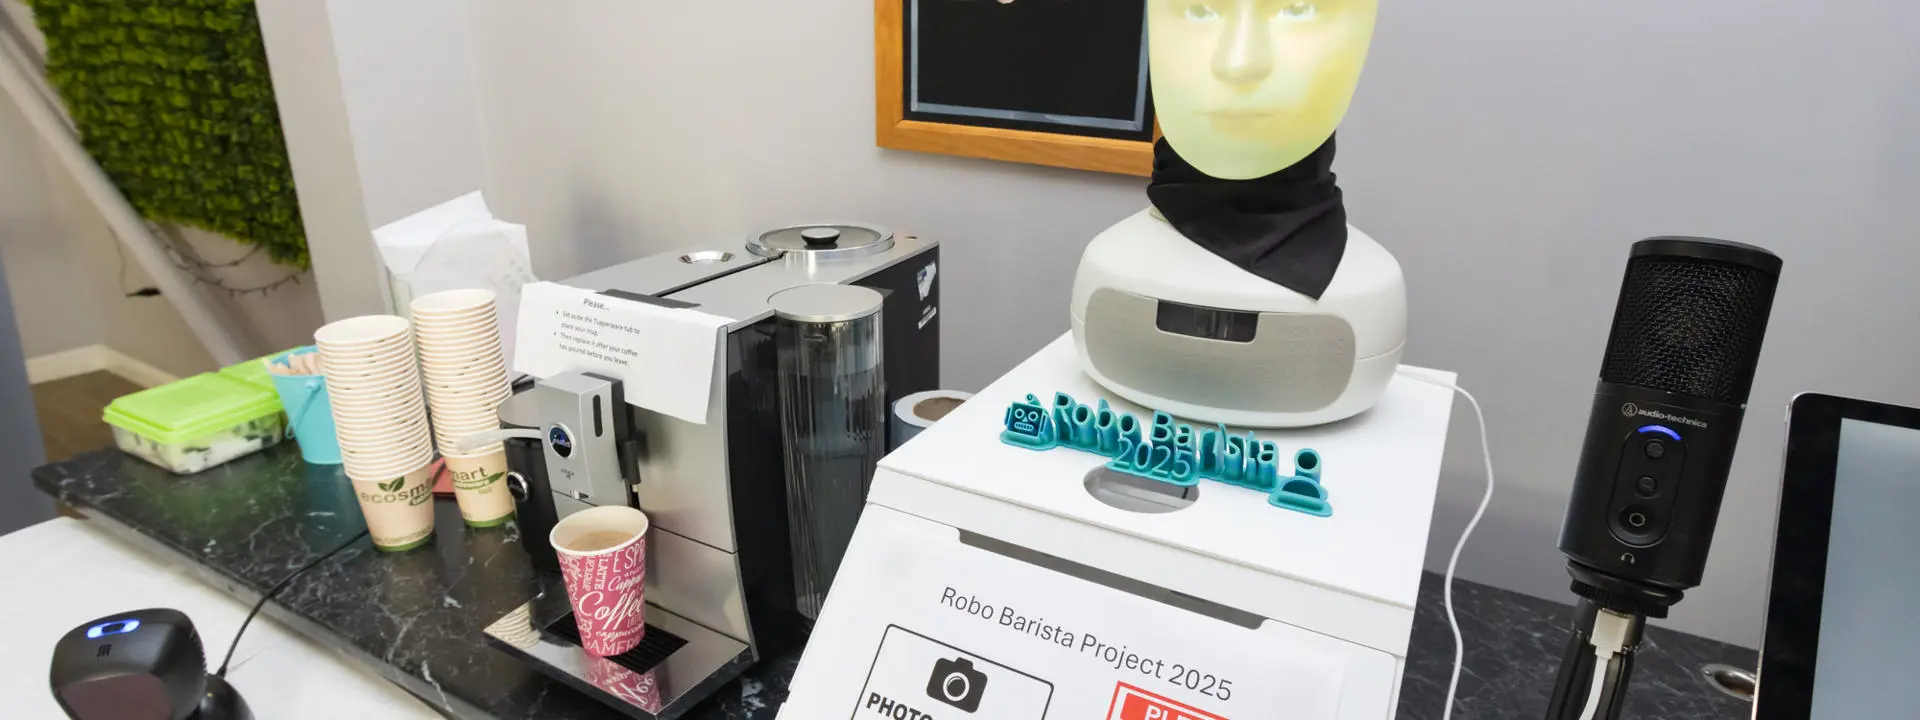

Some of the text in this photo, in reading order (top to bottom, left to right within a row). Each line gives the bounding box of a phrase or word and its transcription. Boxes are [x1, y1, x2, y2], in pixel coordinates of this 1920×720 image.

[1051, 391, 1279, 482] Robo Barista
[1638, 408, 1708, 429] audio-technica
[1112, 436, 1193, 480] 2025
[940, 586, 1233, 701] Robo Barista Project 2025
